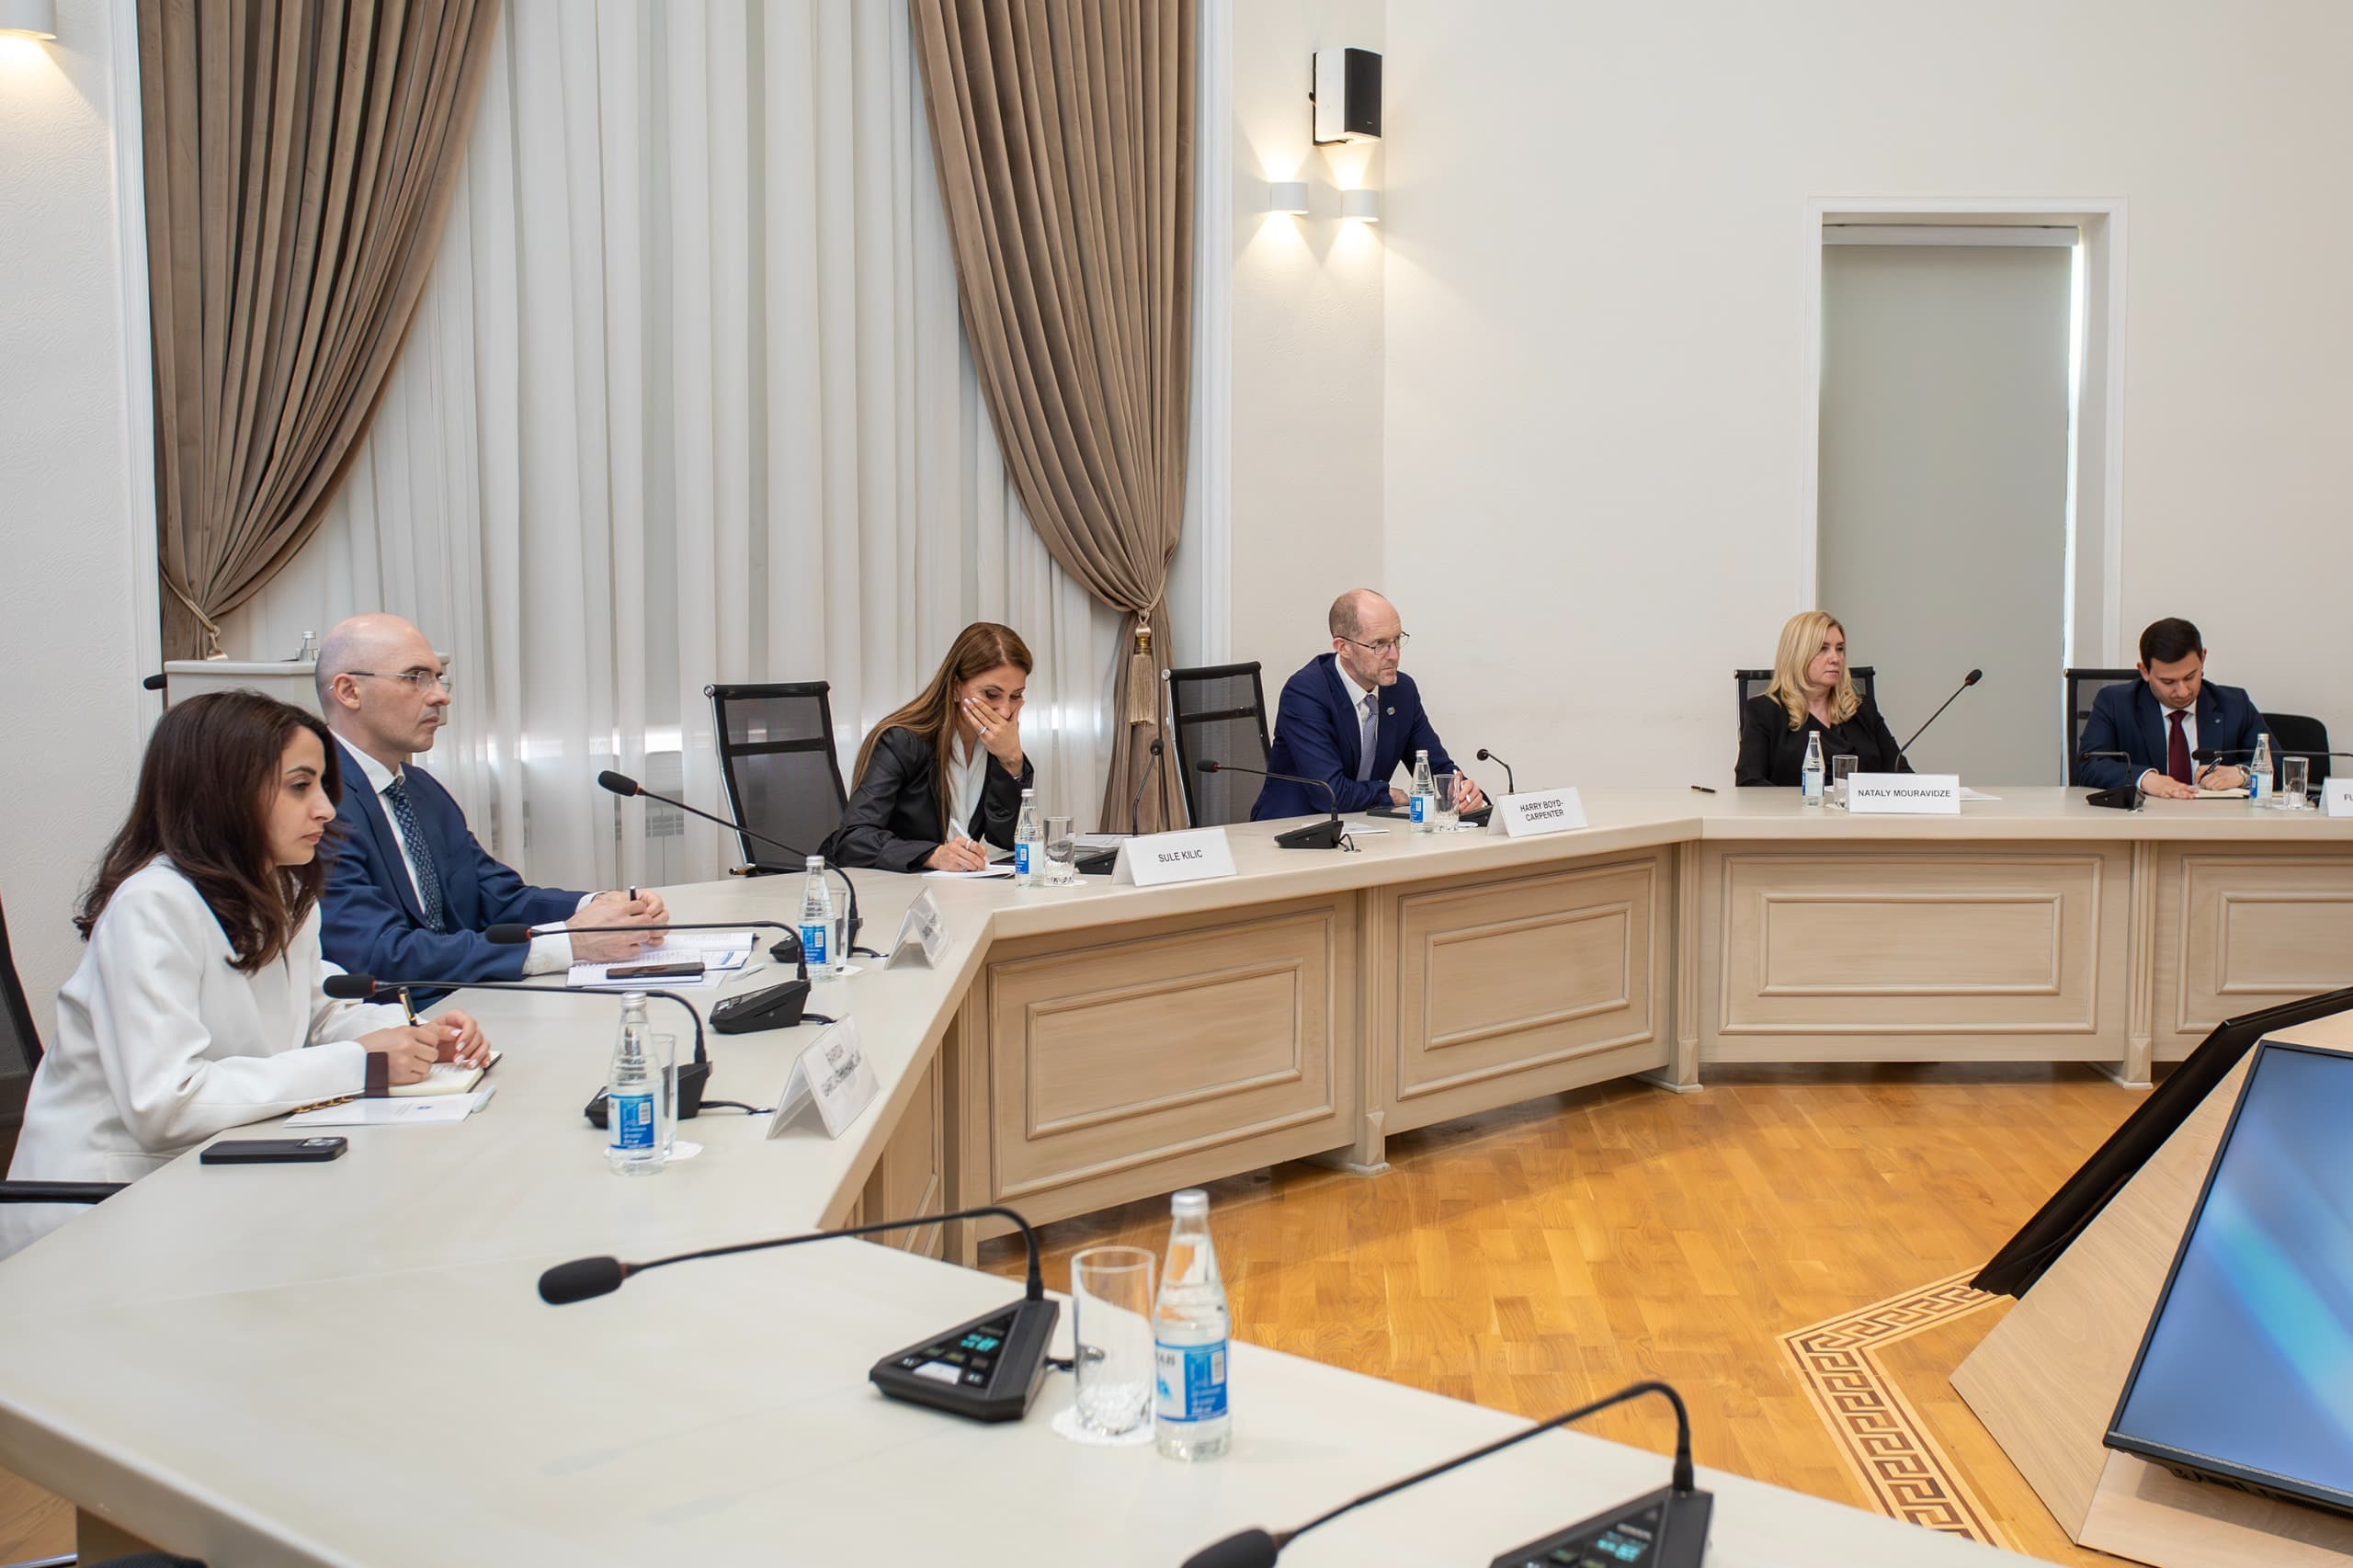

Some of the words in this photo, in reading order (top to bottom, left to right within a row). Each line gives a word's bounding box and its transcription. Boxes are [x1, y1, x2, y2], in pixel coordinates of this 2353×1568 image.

[1858, 790, 1891, 798] NATALY
[1893, 790, 1951, 798] MOURAVIDZE
[1519, 802, 1542, 812] HARRY
[1543, 799, 1563, 809] BOYD-
[1526, 809, 1564, 822] CARPENTER
[1158, 852, 1180, 862] SULE
[1181, 849, 1203, 859] KILIC
